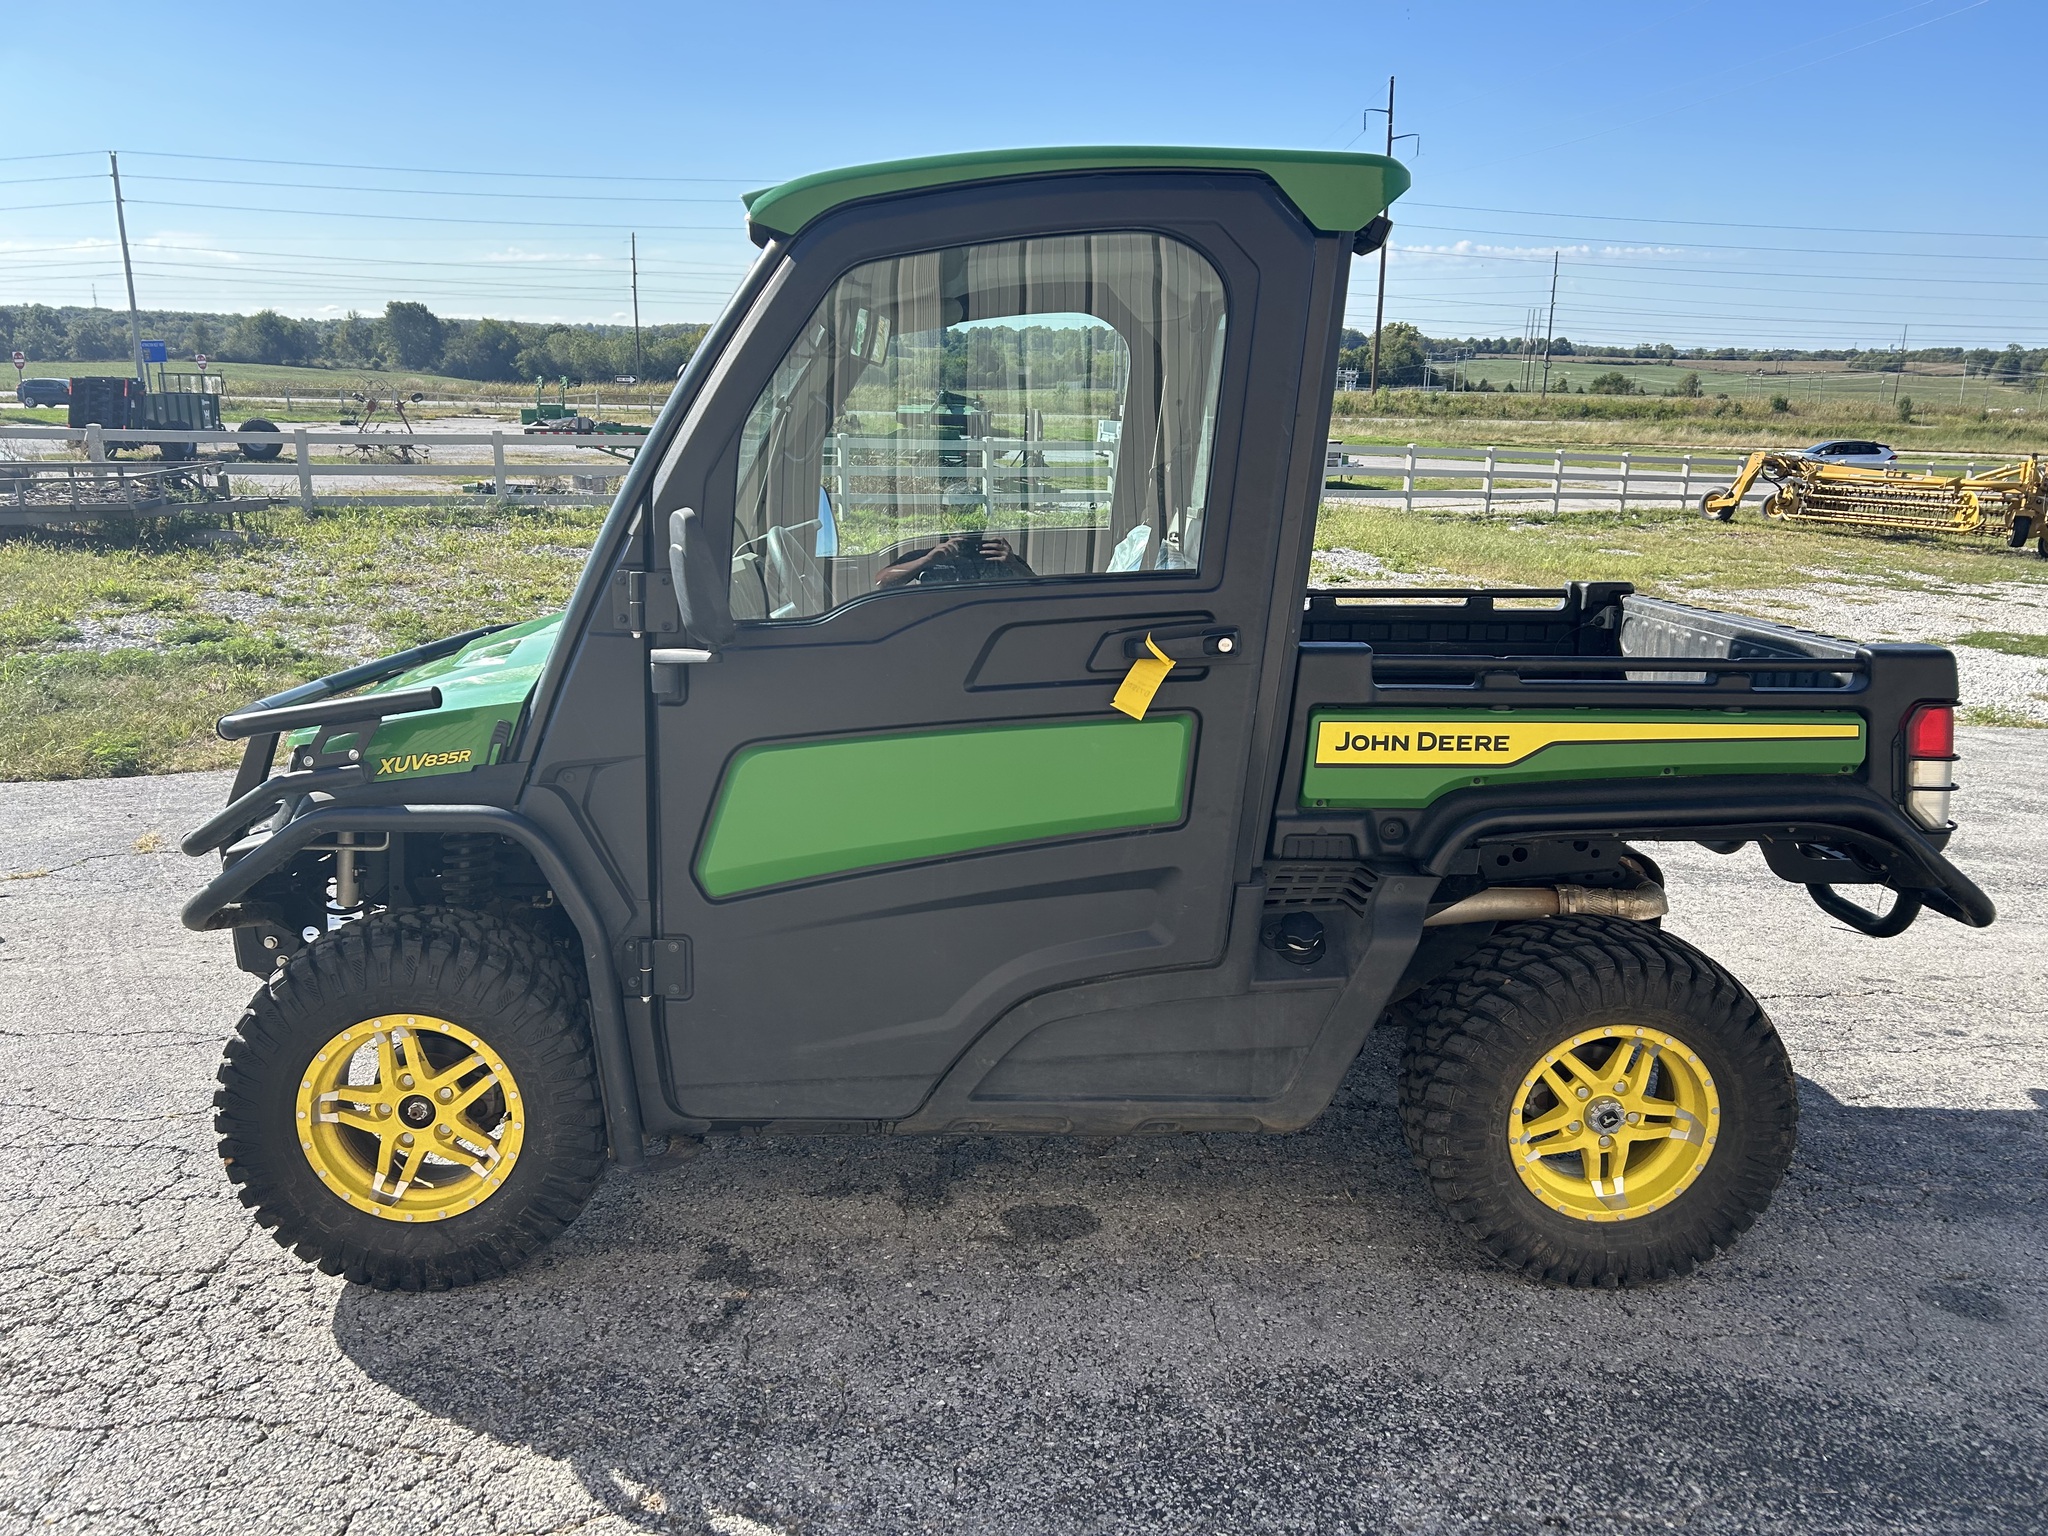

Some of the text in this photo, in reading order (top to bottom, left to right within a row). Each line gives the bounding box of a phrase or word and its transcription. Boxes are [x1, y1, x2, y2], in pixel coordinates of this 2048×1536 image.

[1335, 732, 1510, 751] JOHN DEERE
[377, 749, 472, 775] XUV835R
